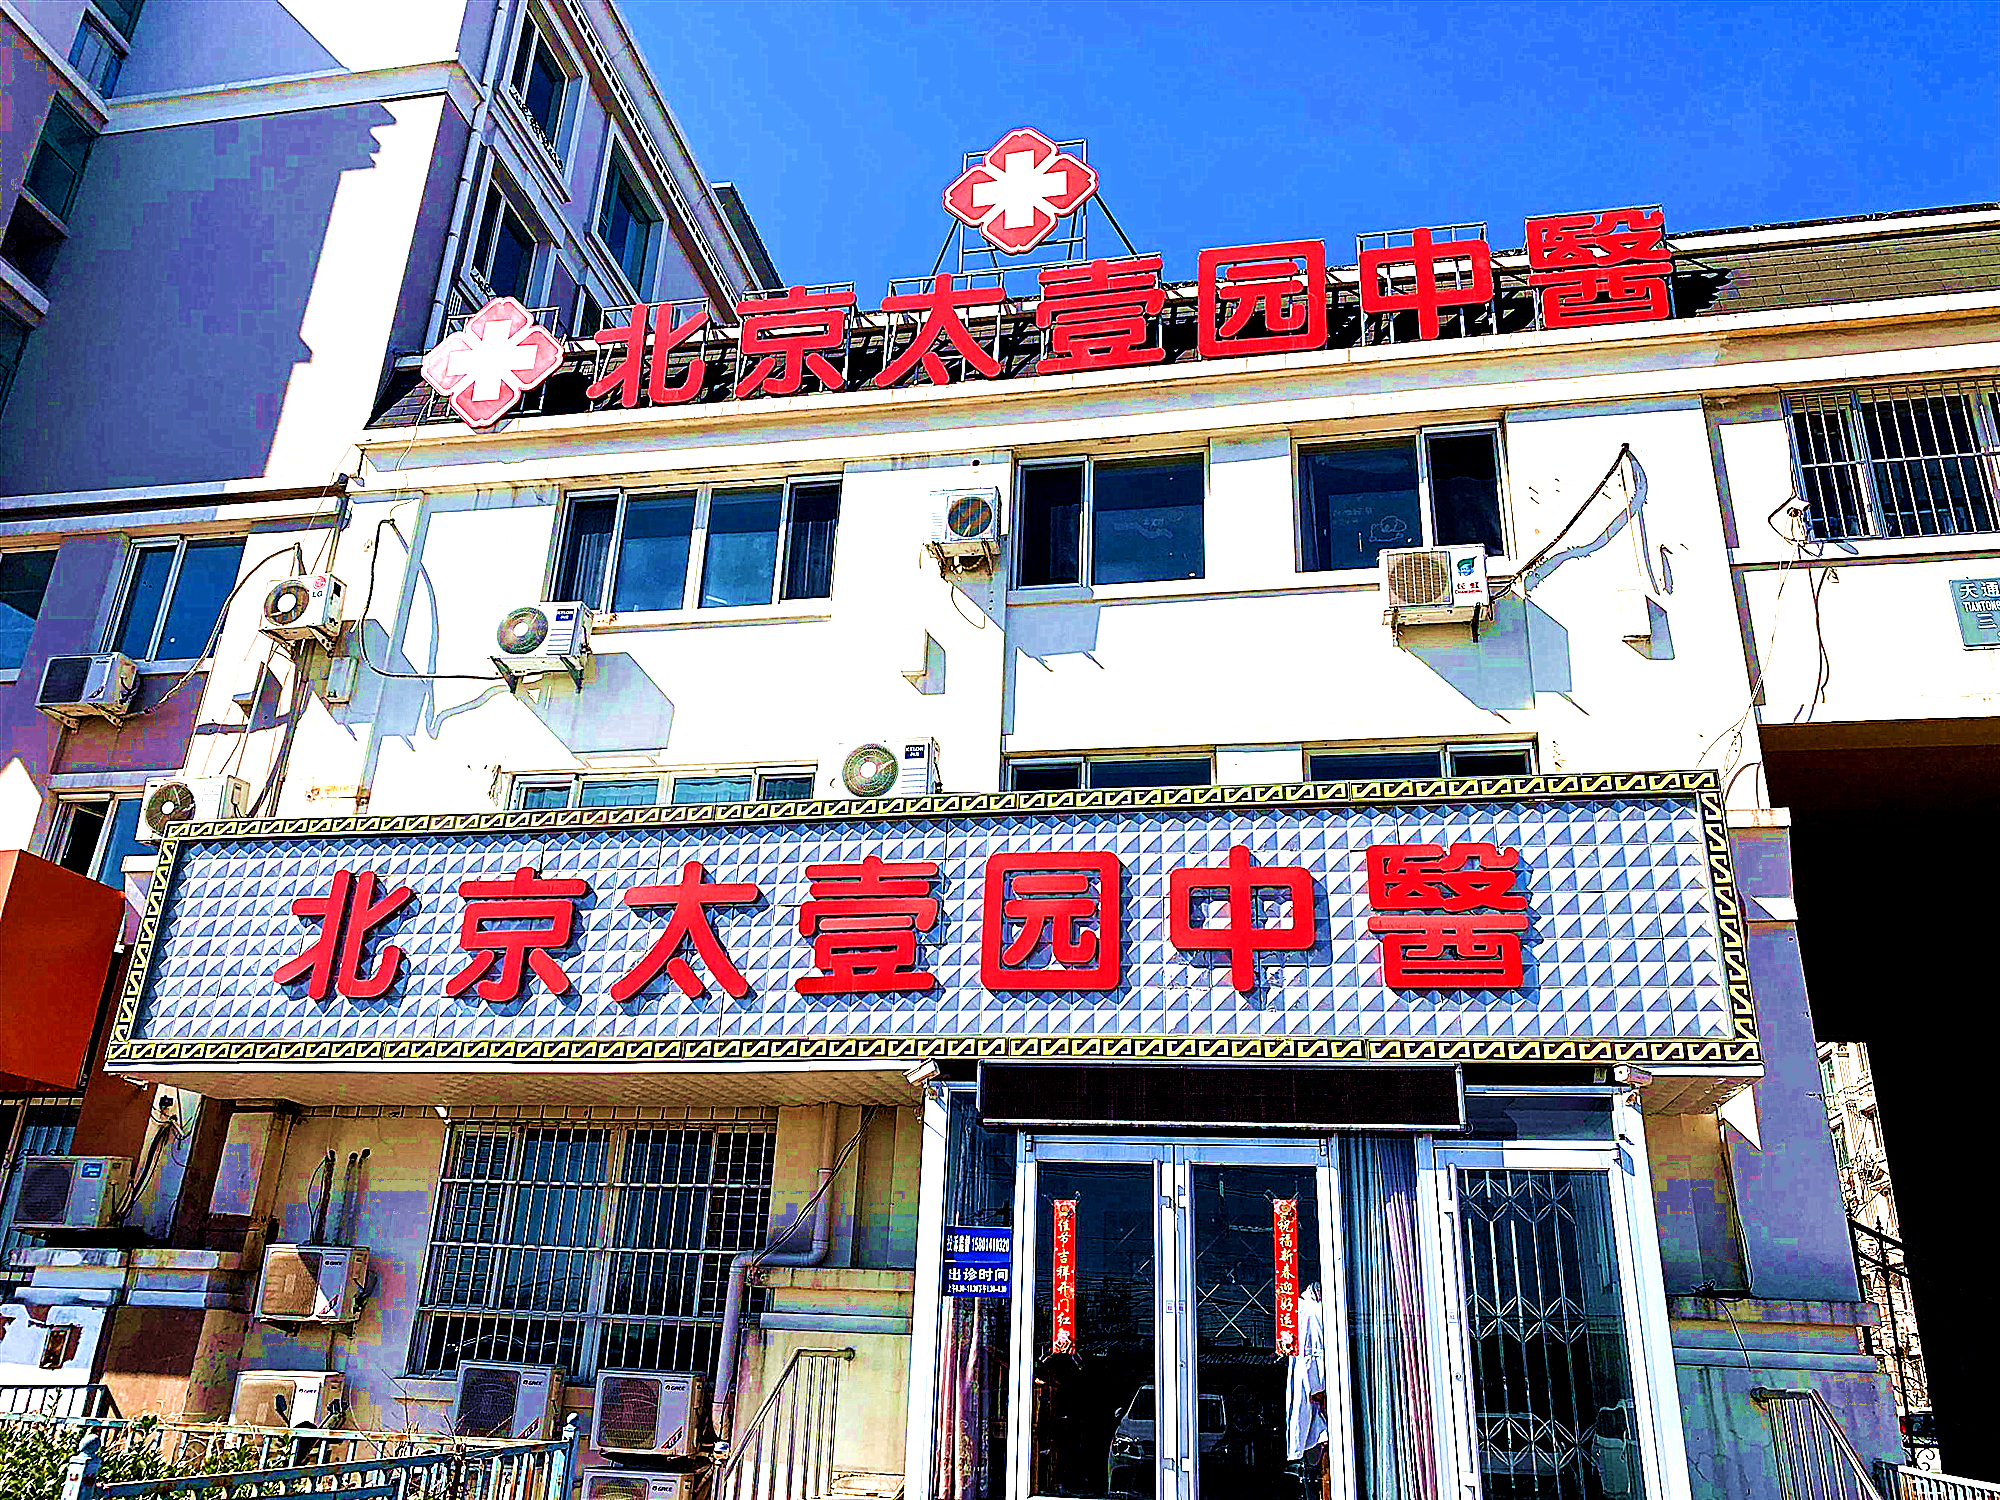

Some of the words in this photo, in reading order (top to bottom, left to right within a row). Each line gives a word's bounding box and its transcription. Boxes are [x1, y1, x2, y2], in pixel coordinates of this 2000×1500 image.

[587, 207, 1675, 407] 北京太壹园中醫
[275, 841, 1530, 1003] 北京太壹园中醫
[948, 1267, 1009, 1282] 出诊时间
[1056, 1219, 1072, 1327] 佳节吉祥开门红
[1277, 1215, 1296, 1328] 祝福新春迎好运
